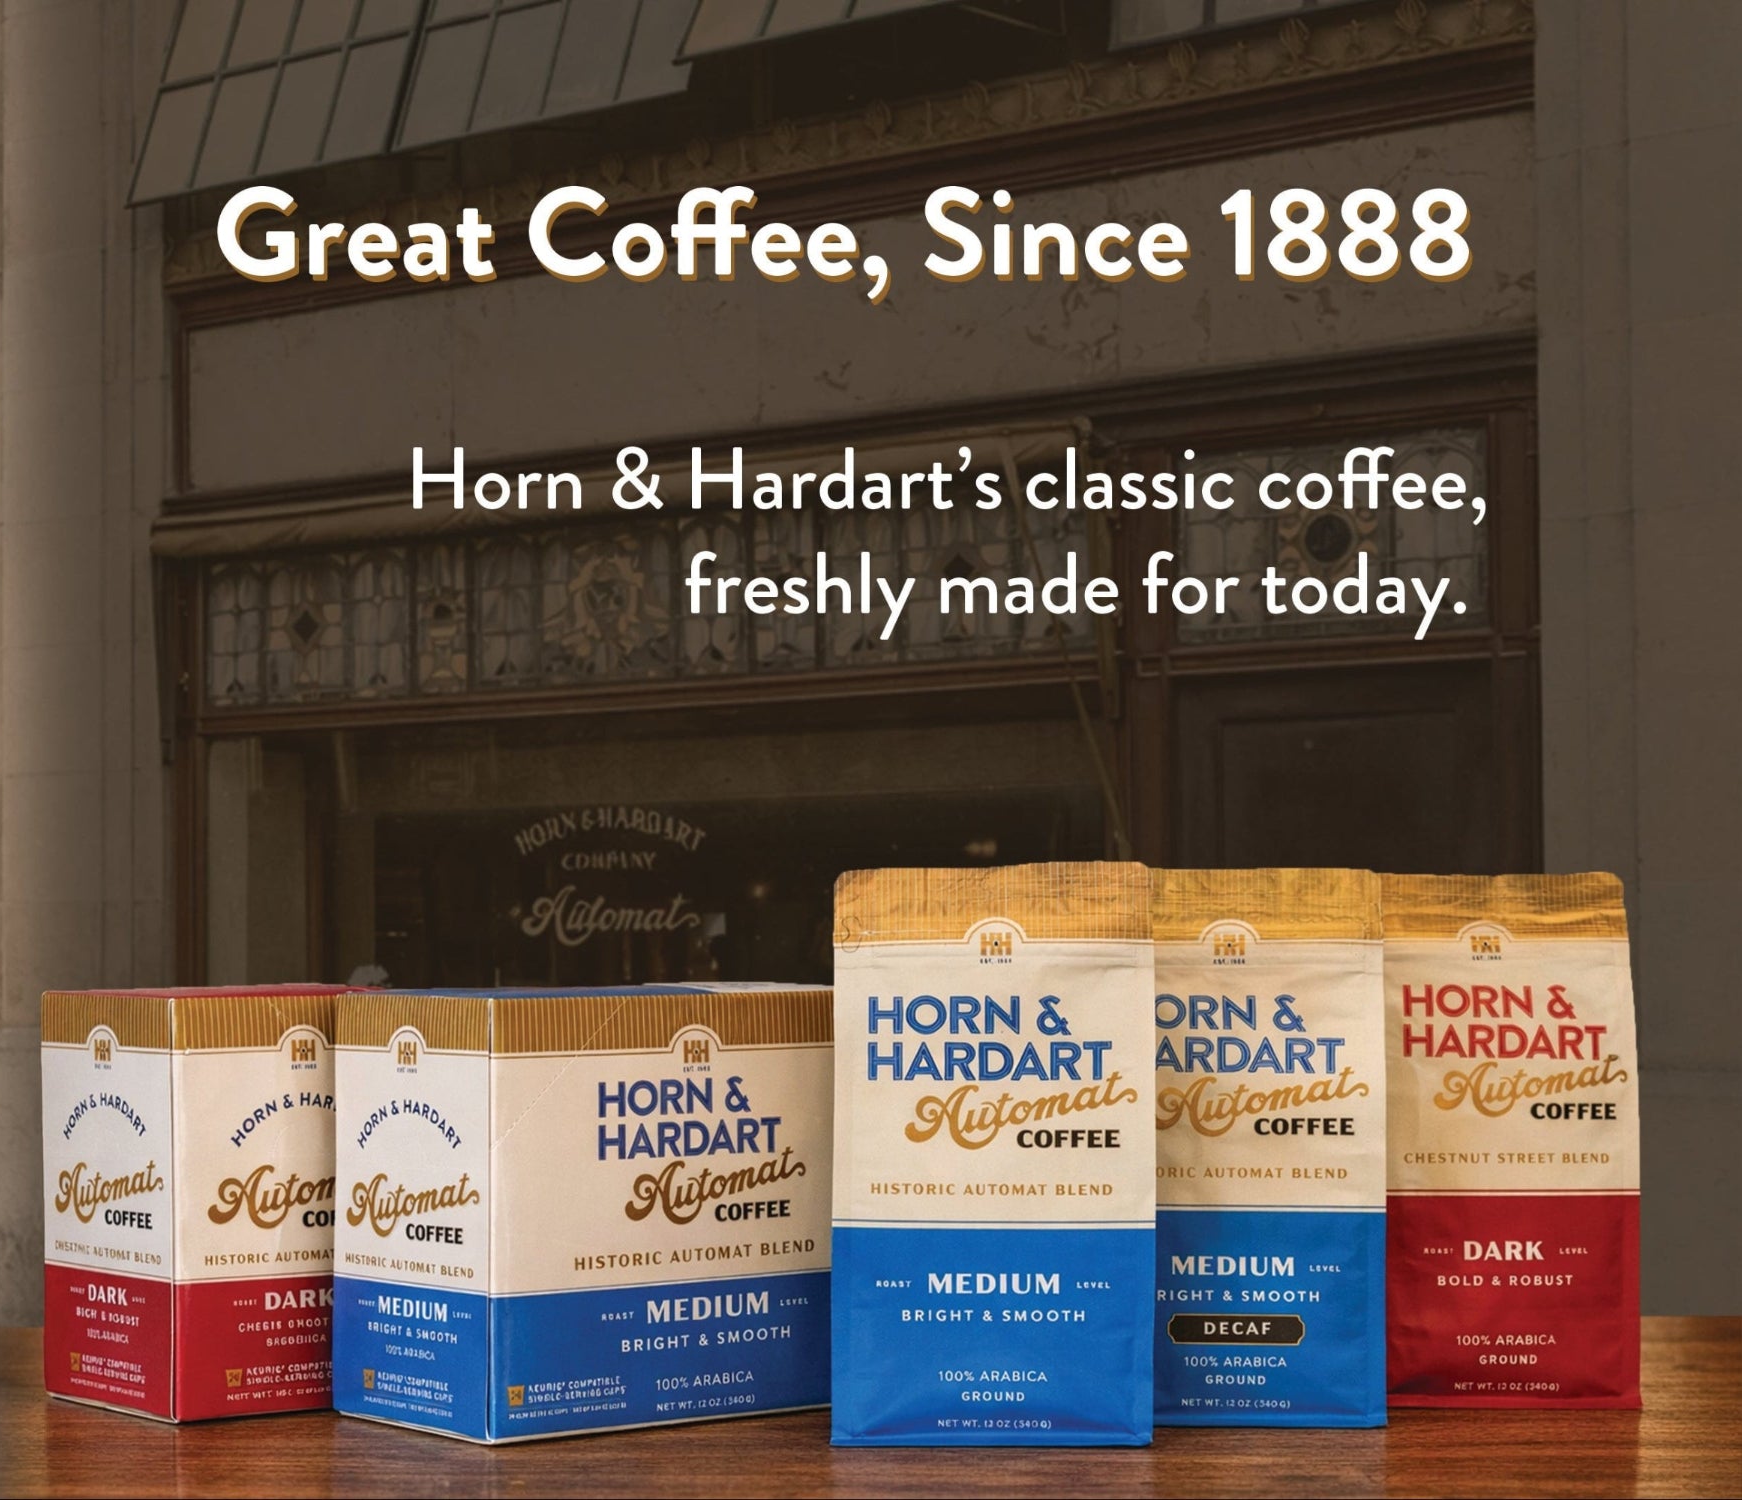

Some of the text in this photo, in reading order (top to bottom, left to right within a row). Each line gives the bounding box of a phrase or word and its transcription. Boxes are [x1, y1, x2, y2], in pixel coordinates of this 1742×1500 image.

[514, 810, 576, 856] HORN
[598, 806, 706, 850] HARDART
[521, 885, 700, 946] Automat
[1155, 993, 1306, 1032] ORN &
[1402, 984, 1577, 1020] HORN &
[868, 995, 1072, 1036] HORN &
[1402, 1023, 1607, 1061] HARDART
[867, 1041, 1112, 1081] HARDART
[1155, 1036, 1345, 1074] ARDART
[598, 1076, 752, 1118] HORN &
[1433, 1054, 1628, 1118] Automat
[904, 1071, 1138, 1150] Automat
[1155, 1066, 1370, 1137] Automat
[1530, 1102, 1617, 1120] COFFEE
[63, 1099, 89, 1140] HORN
[99, 1092, 147, 1137] HARDART
[230, 1100, 278, 1148] HORN
[283, 1094, 294, 1109] &
[357, 1099, 462, 1150] HORN & HARDART
[1254, 1117, 1355, 1136] COFFEE
[598, 1116, 781, 1161] HARDART
[1016, 1129, 1121, 1149] COFFEE
[1403, 1152, 1610, 1164] CHESTNUT STREET BLEND
[1156, 1167, 1348, 1180] ORIC AUTOMAT BLEND
[55, 1160, 163, 1224] Automat
[625, 1146, 807, 1225] Automat
[870, 1183, 1113, 1196] HISTORIC AUTOMAT BLEND
[346, 1173, 480, 1238] Automat
[714, 1200, 791, 1222] COFFEE
[104, 1209, 153, 1230] COFFEE
[405, 1223, 464, 1245] COFFEE
[205, 1253, 268, 1266] HISTORIC
[574, 1238, 815, 1271] HISTORIC AUTOMAT BLEND
[1463, 1240, 1544, 1261] DARK
[345, 1252, 386, 1268] HISTORIC
[440, 1265, 474, 1279] BLEND
[1171, 1255, 1295, 1277] MEDIUM
[927, 1272, 1060, 1294] MEDIUM
[1437, 1274, 1574, 1287] BOLD & ROBUST
[88, 1284, 128, 1306] DARK
[264, 1288, 334, 1311] DARK
[1157, 1290, 1320, 1302] RIGHT & SMOOTH
[378, 1295, 448, 1322] MEDIUM
[646, 1291, 769, 1325] MEDIUM
[901, 1309, 1086, 1322] BRIGHT & SMOOTH
[621, 1325, 791, 1353] BRIGHT & SMOOTH
[1203, 1321, 1272, 1336] DECAF
[1456, 1334, 1557, 1346] 100% ARABICA
[1184, 1356, 1287, 1368] 100% ARABICA
[1479, 1354, 1538, 1365] GROUND
[655, 1370, 754, 1391] 100% ARABICA
[938, 1370, 1048, 1382] 100% ARABICA
[1205, 1375, 1267, 1386] GROUND
[1454, 1382, 1474, 1391] NET
[656, 1401, 678, 1412] NET
[961, 1391, 1025, 1402] GROUND
[1181, 1398, 1201, 1407] NET
[937, 1419, 959, 1428] NET
